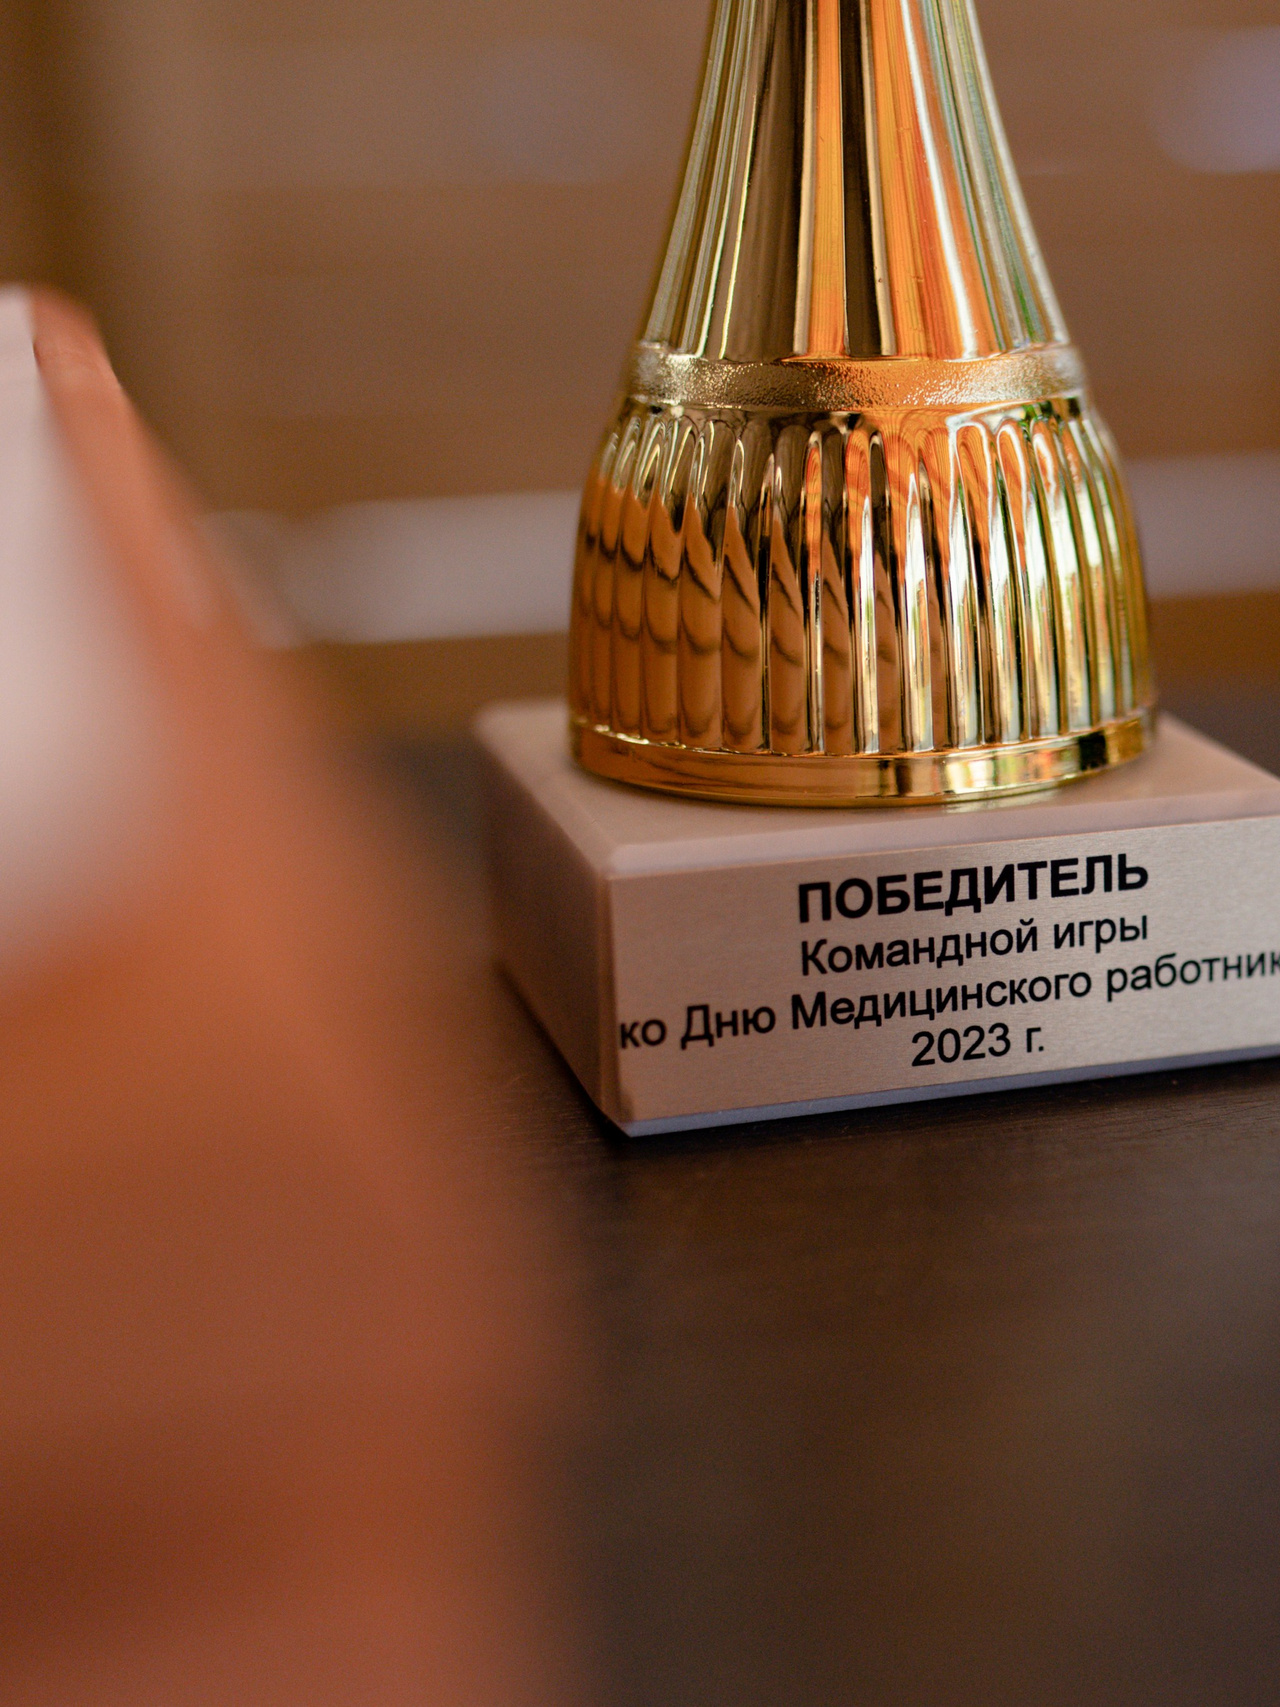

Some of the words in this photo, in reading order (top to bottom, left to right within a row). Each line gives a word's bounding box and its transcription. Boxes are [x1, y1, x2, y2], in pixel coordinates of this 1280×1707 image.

[798, 853, 1149, 923] ПОБЕДИТЕЛЬ
[801, 918, 1038, 976] Командной
[1053, 915, 1148, 954] игры
[620, 1018, 667, 1049] ко
[680, 1004, 776, 1050] Дню
[791, 971, 1092, 1030] Медицинского
[911, 1022, 1012, 1067] 2023
[1025, 1027, 1045, 1054] г.
